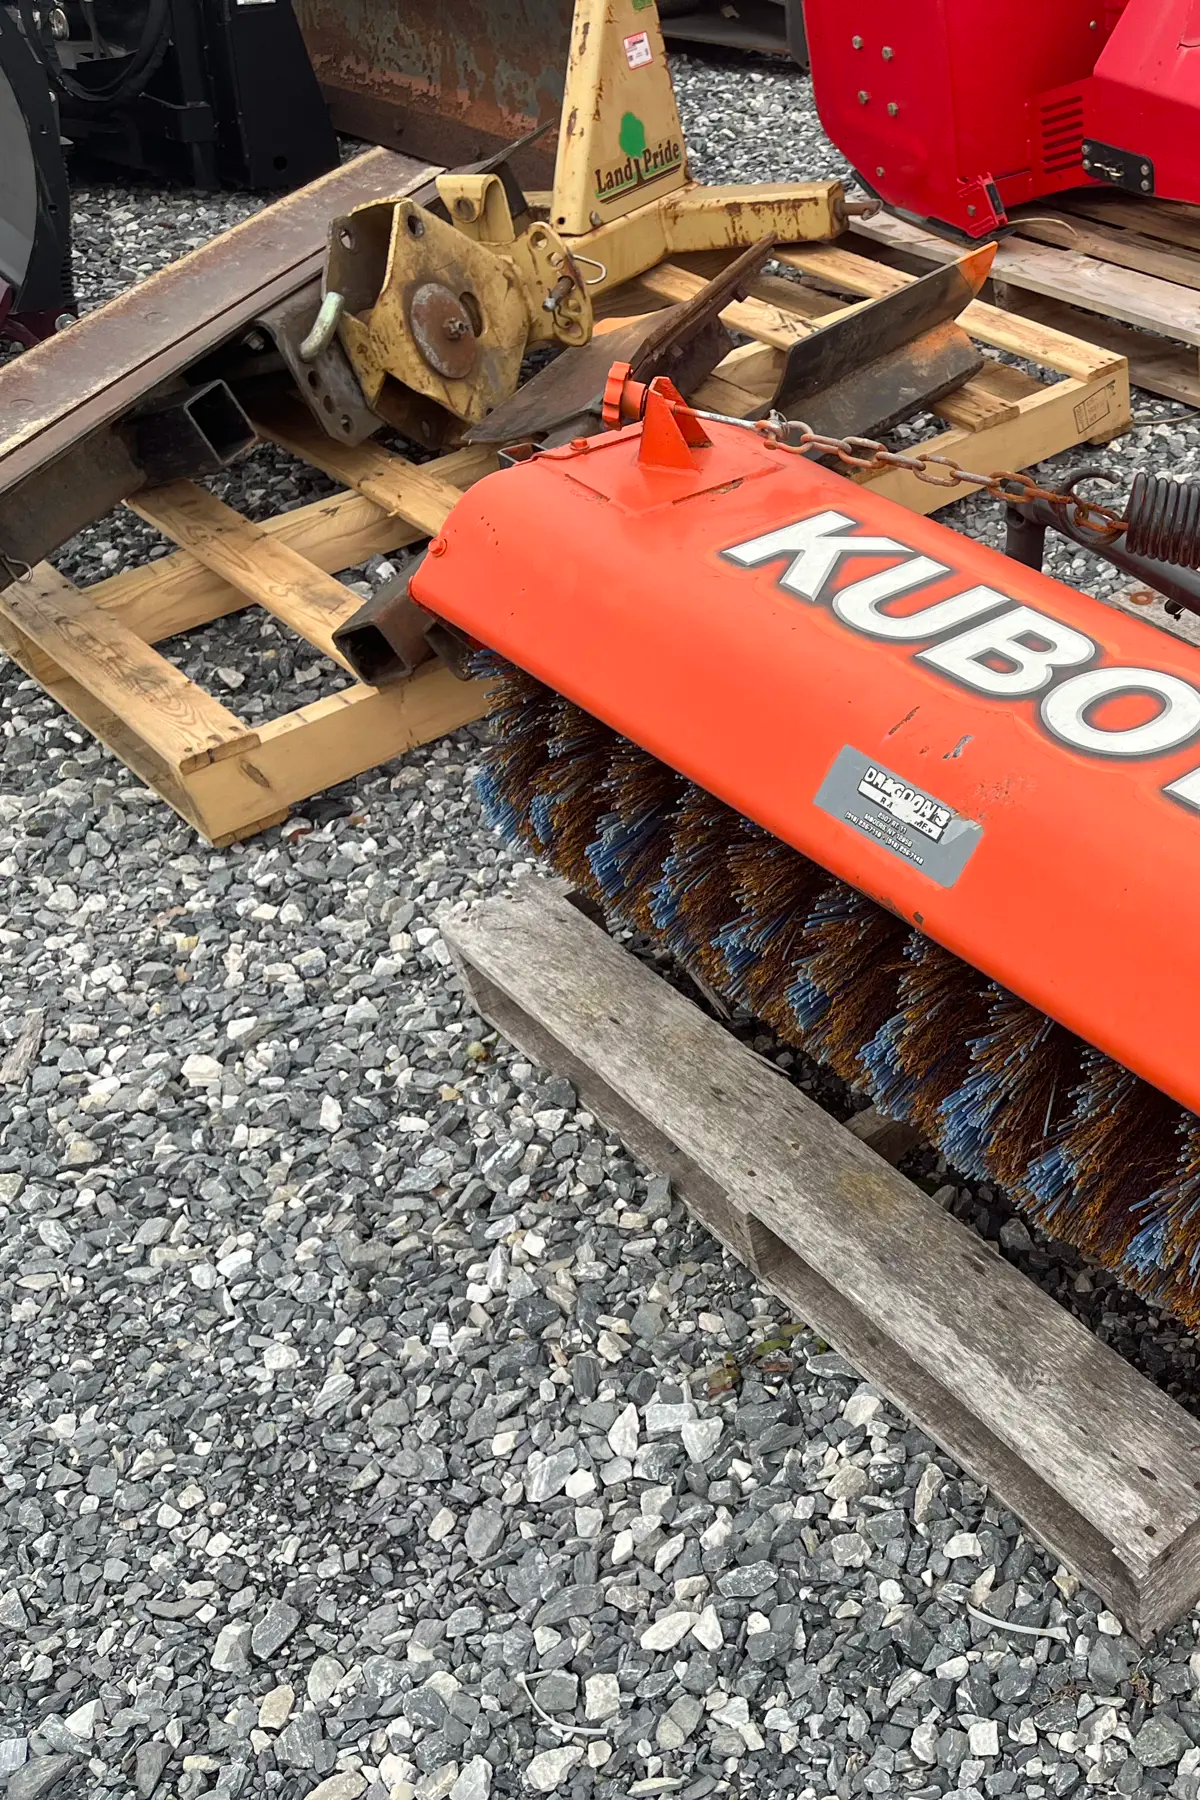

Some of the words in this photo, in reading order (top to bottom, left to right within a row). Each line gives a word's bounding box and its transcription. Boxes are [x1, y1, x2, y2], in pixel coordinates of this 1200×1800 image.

[595, 156, 633, 194] Land
[642, 139, 680, 173] Pride
[877, 812, 892, 825] 2507
[899, 825, 907, 834] 11
[886, 828, 897, 837] NY
